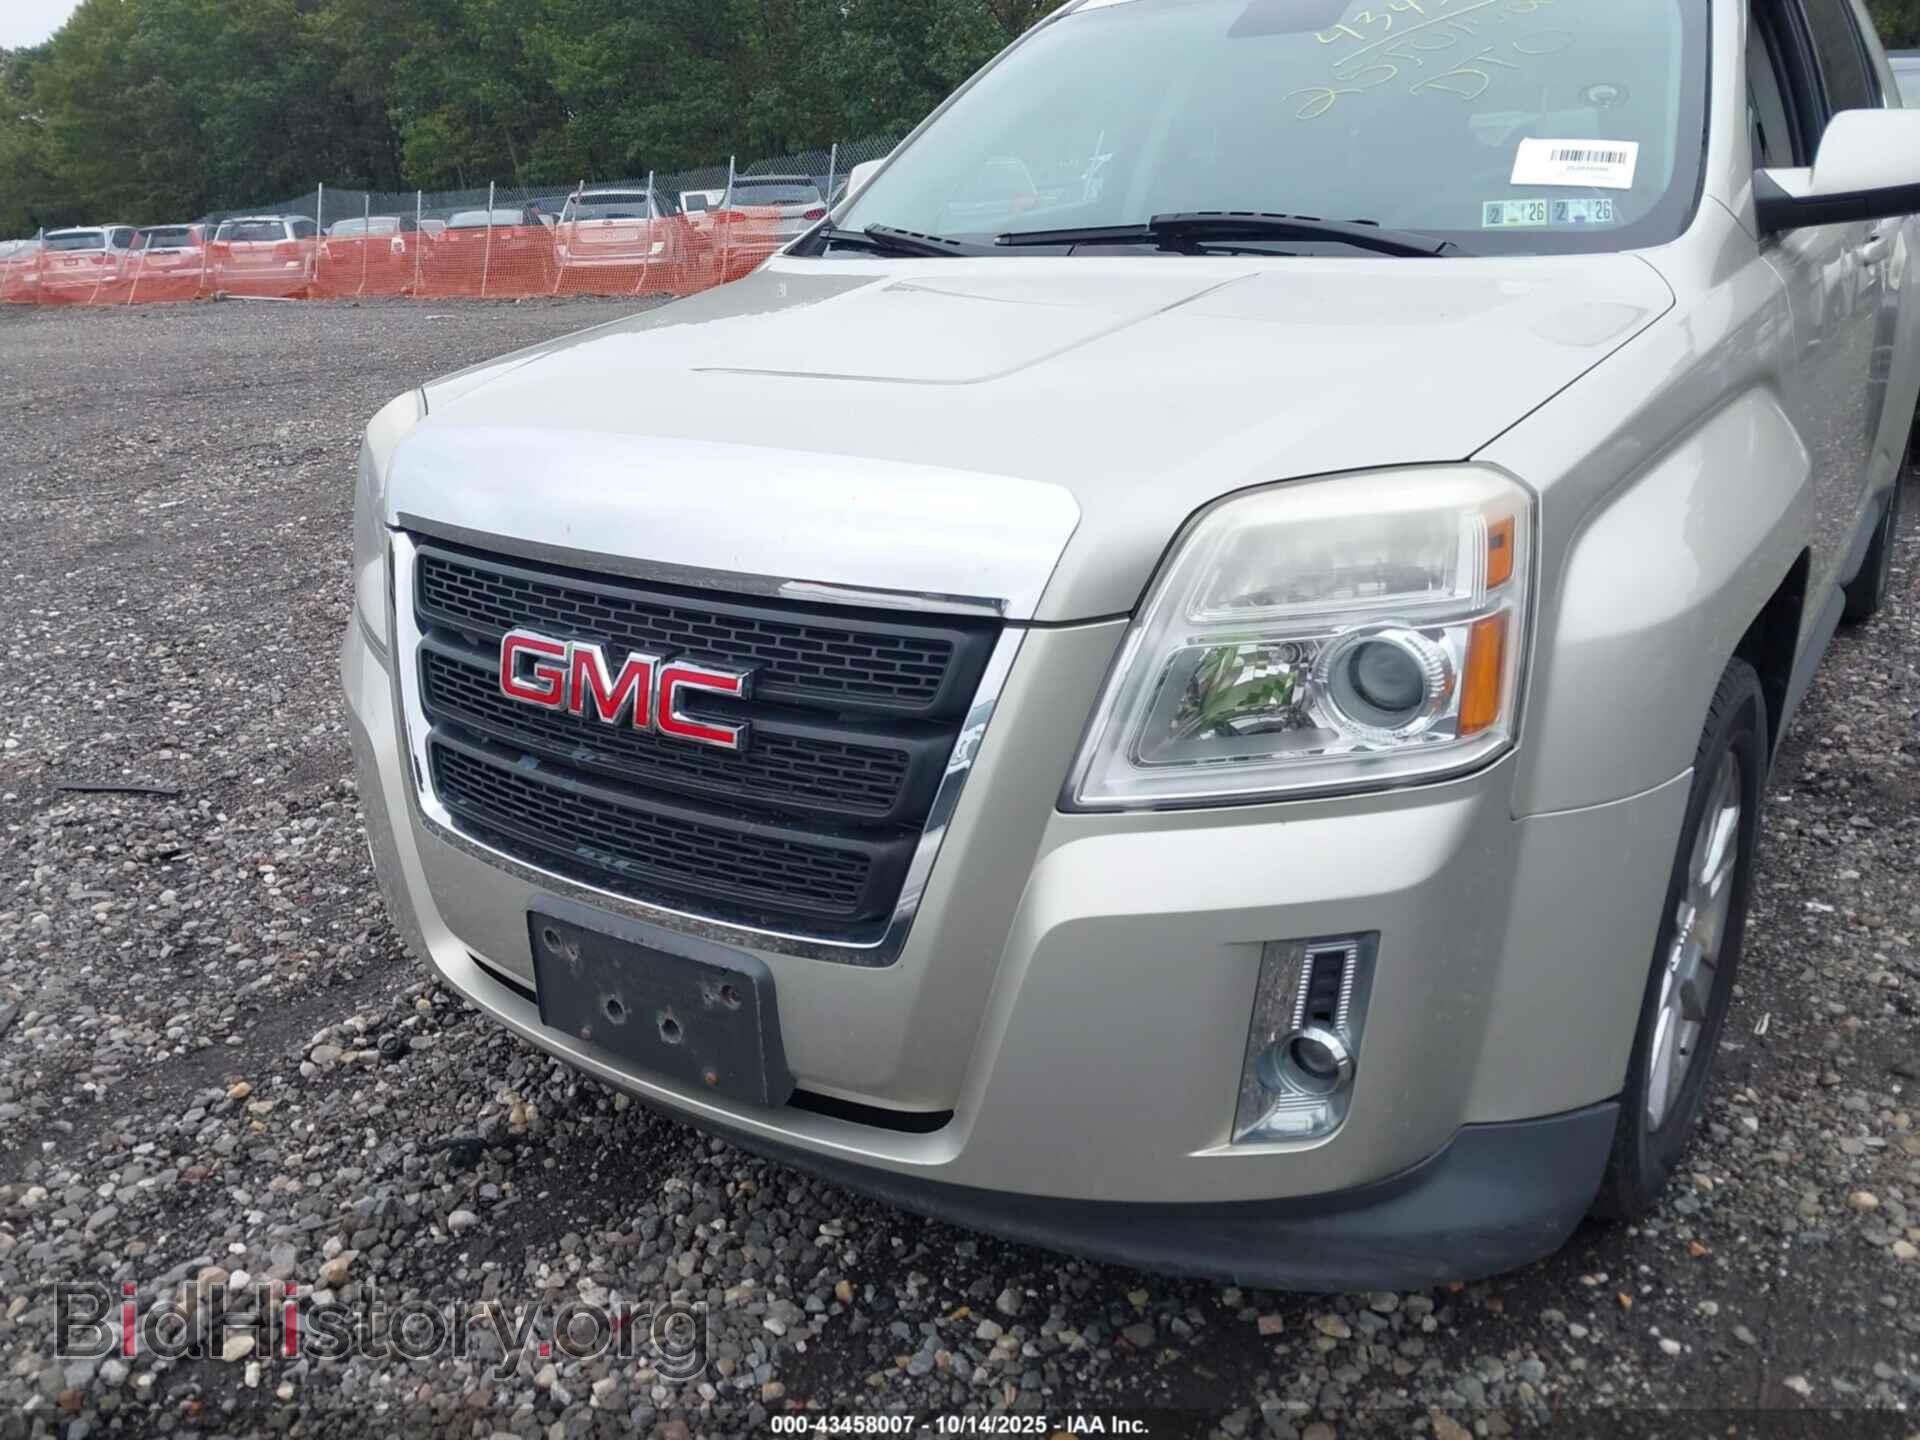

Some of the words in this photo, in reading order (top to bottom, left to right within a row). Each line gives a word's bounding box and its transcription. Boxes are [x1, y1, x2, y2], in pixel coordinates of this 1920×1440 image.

[1529, 202, 1545, 221] 26
[1555, 201, 1567, 221] 2
[1595, 201, 1611, 221] 26
[500, 628, 749, 749] GMC
